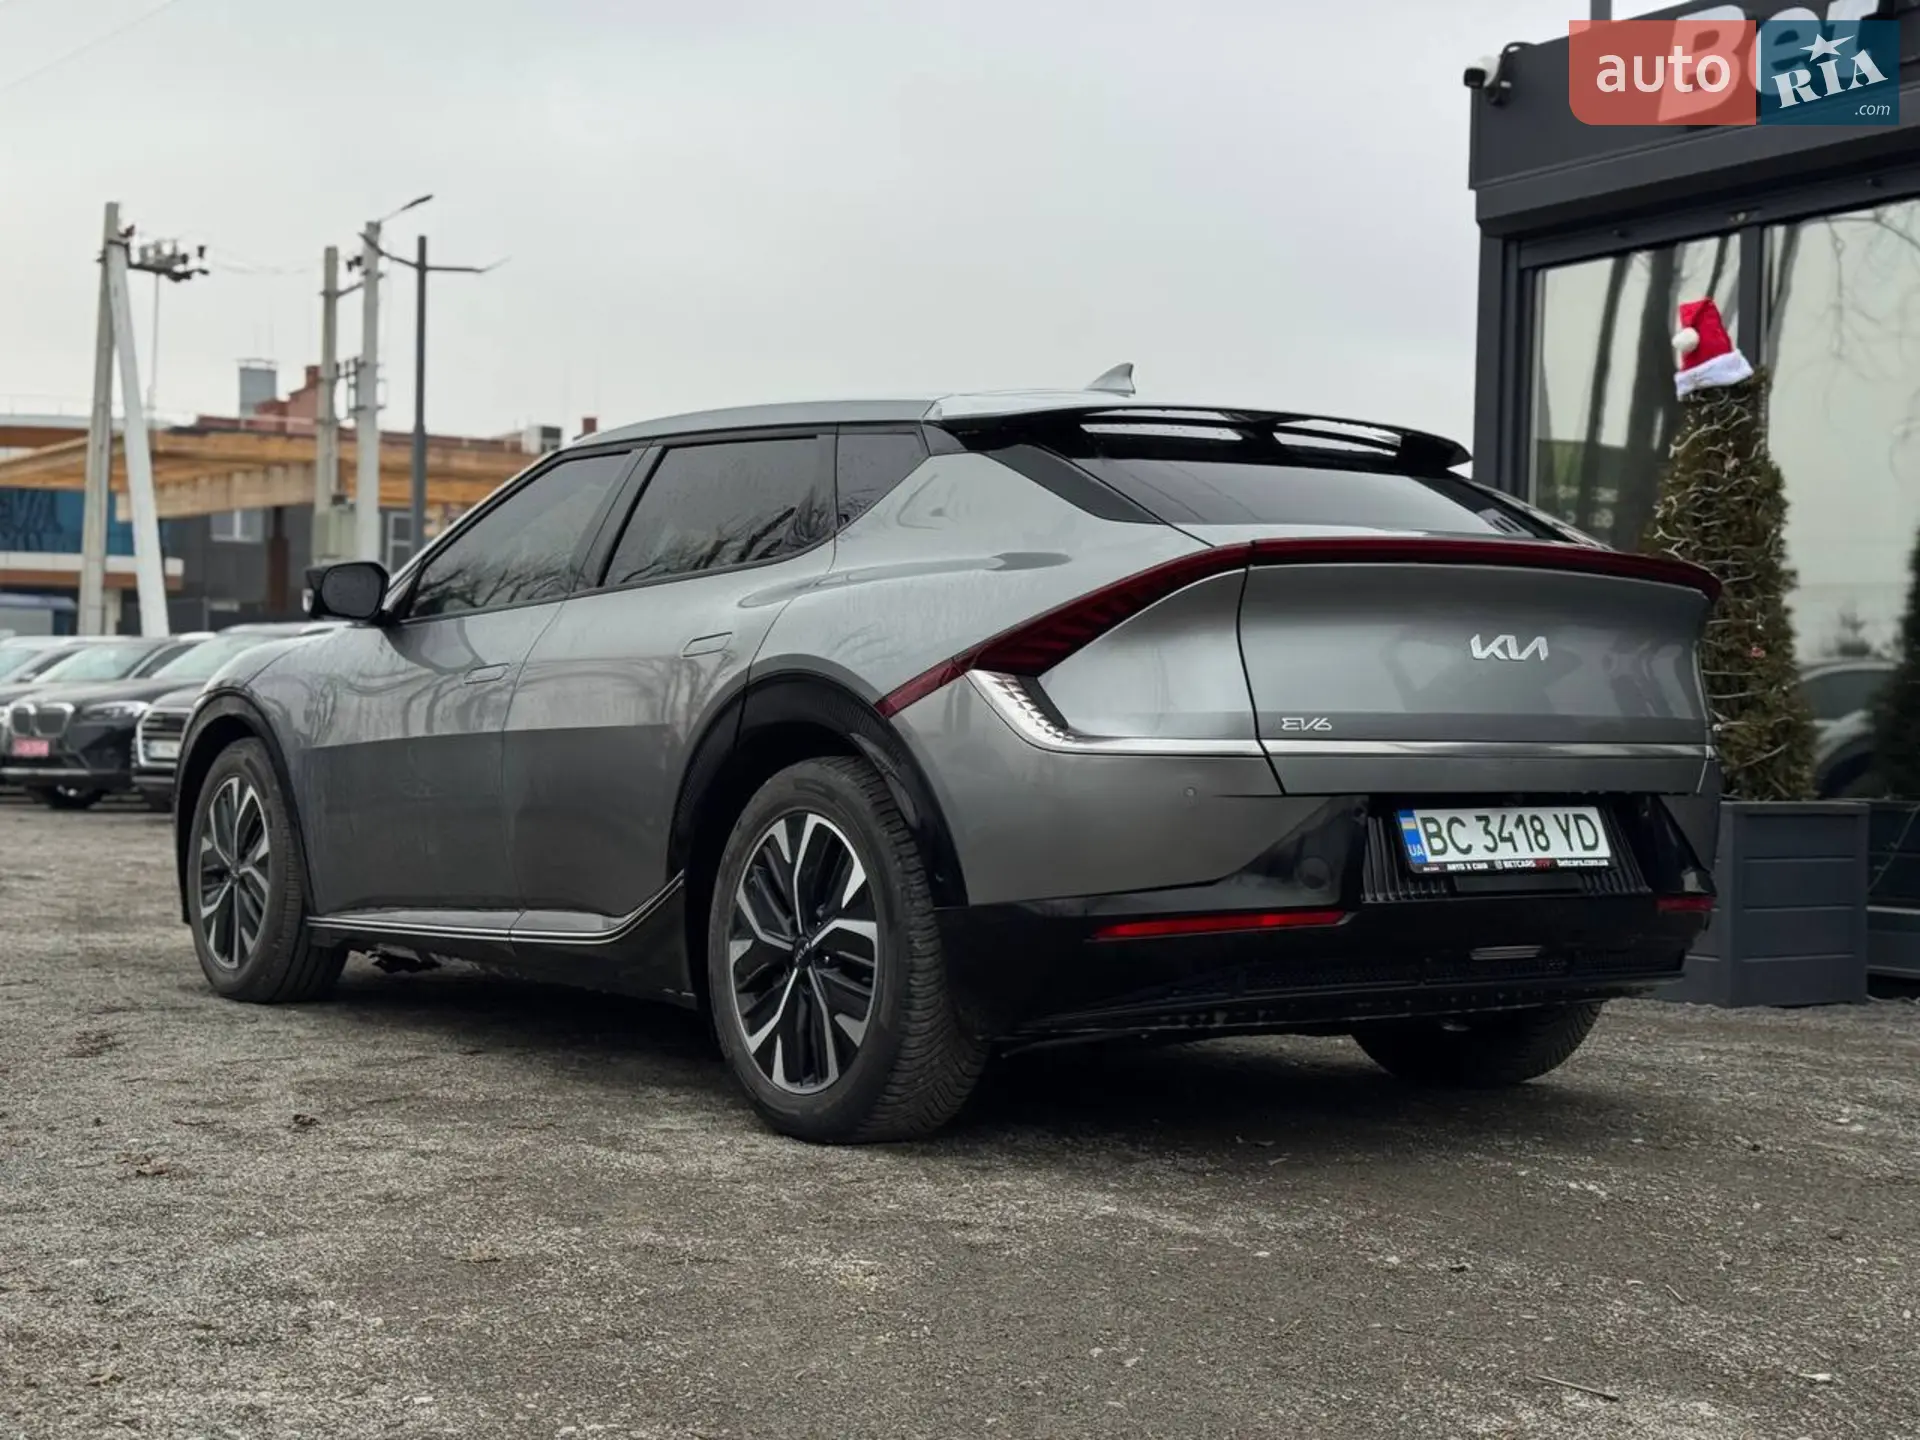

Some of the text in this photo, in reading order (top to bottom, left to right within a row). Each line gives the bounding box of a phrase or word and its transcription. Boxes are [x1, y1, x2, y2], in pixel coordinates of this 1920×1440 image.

[1470, 633, 1549, 661] KIA
[1281, 717, 1332, 731] EV6
[1420, 812, 1600, 856] BC 3418 YD
[1407, 843, 1425, 857] UA
